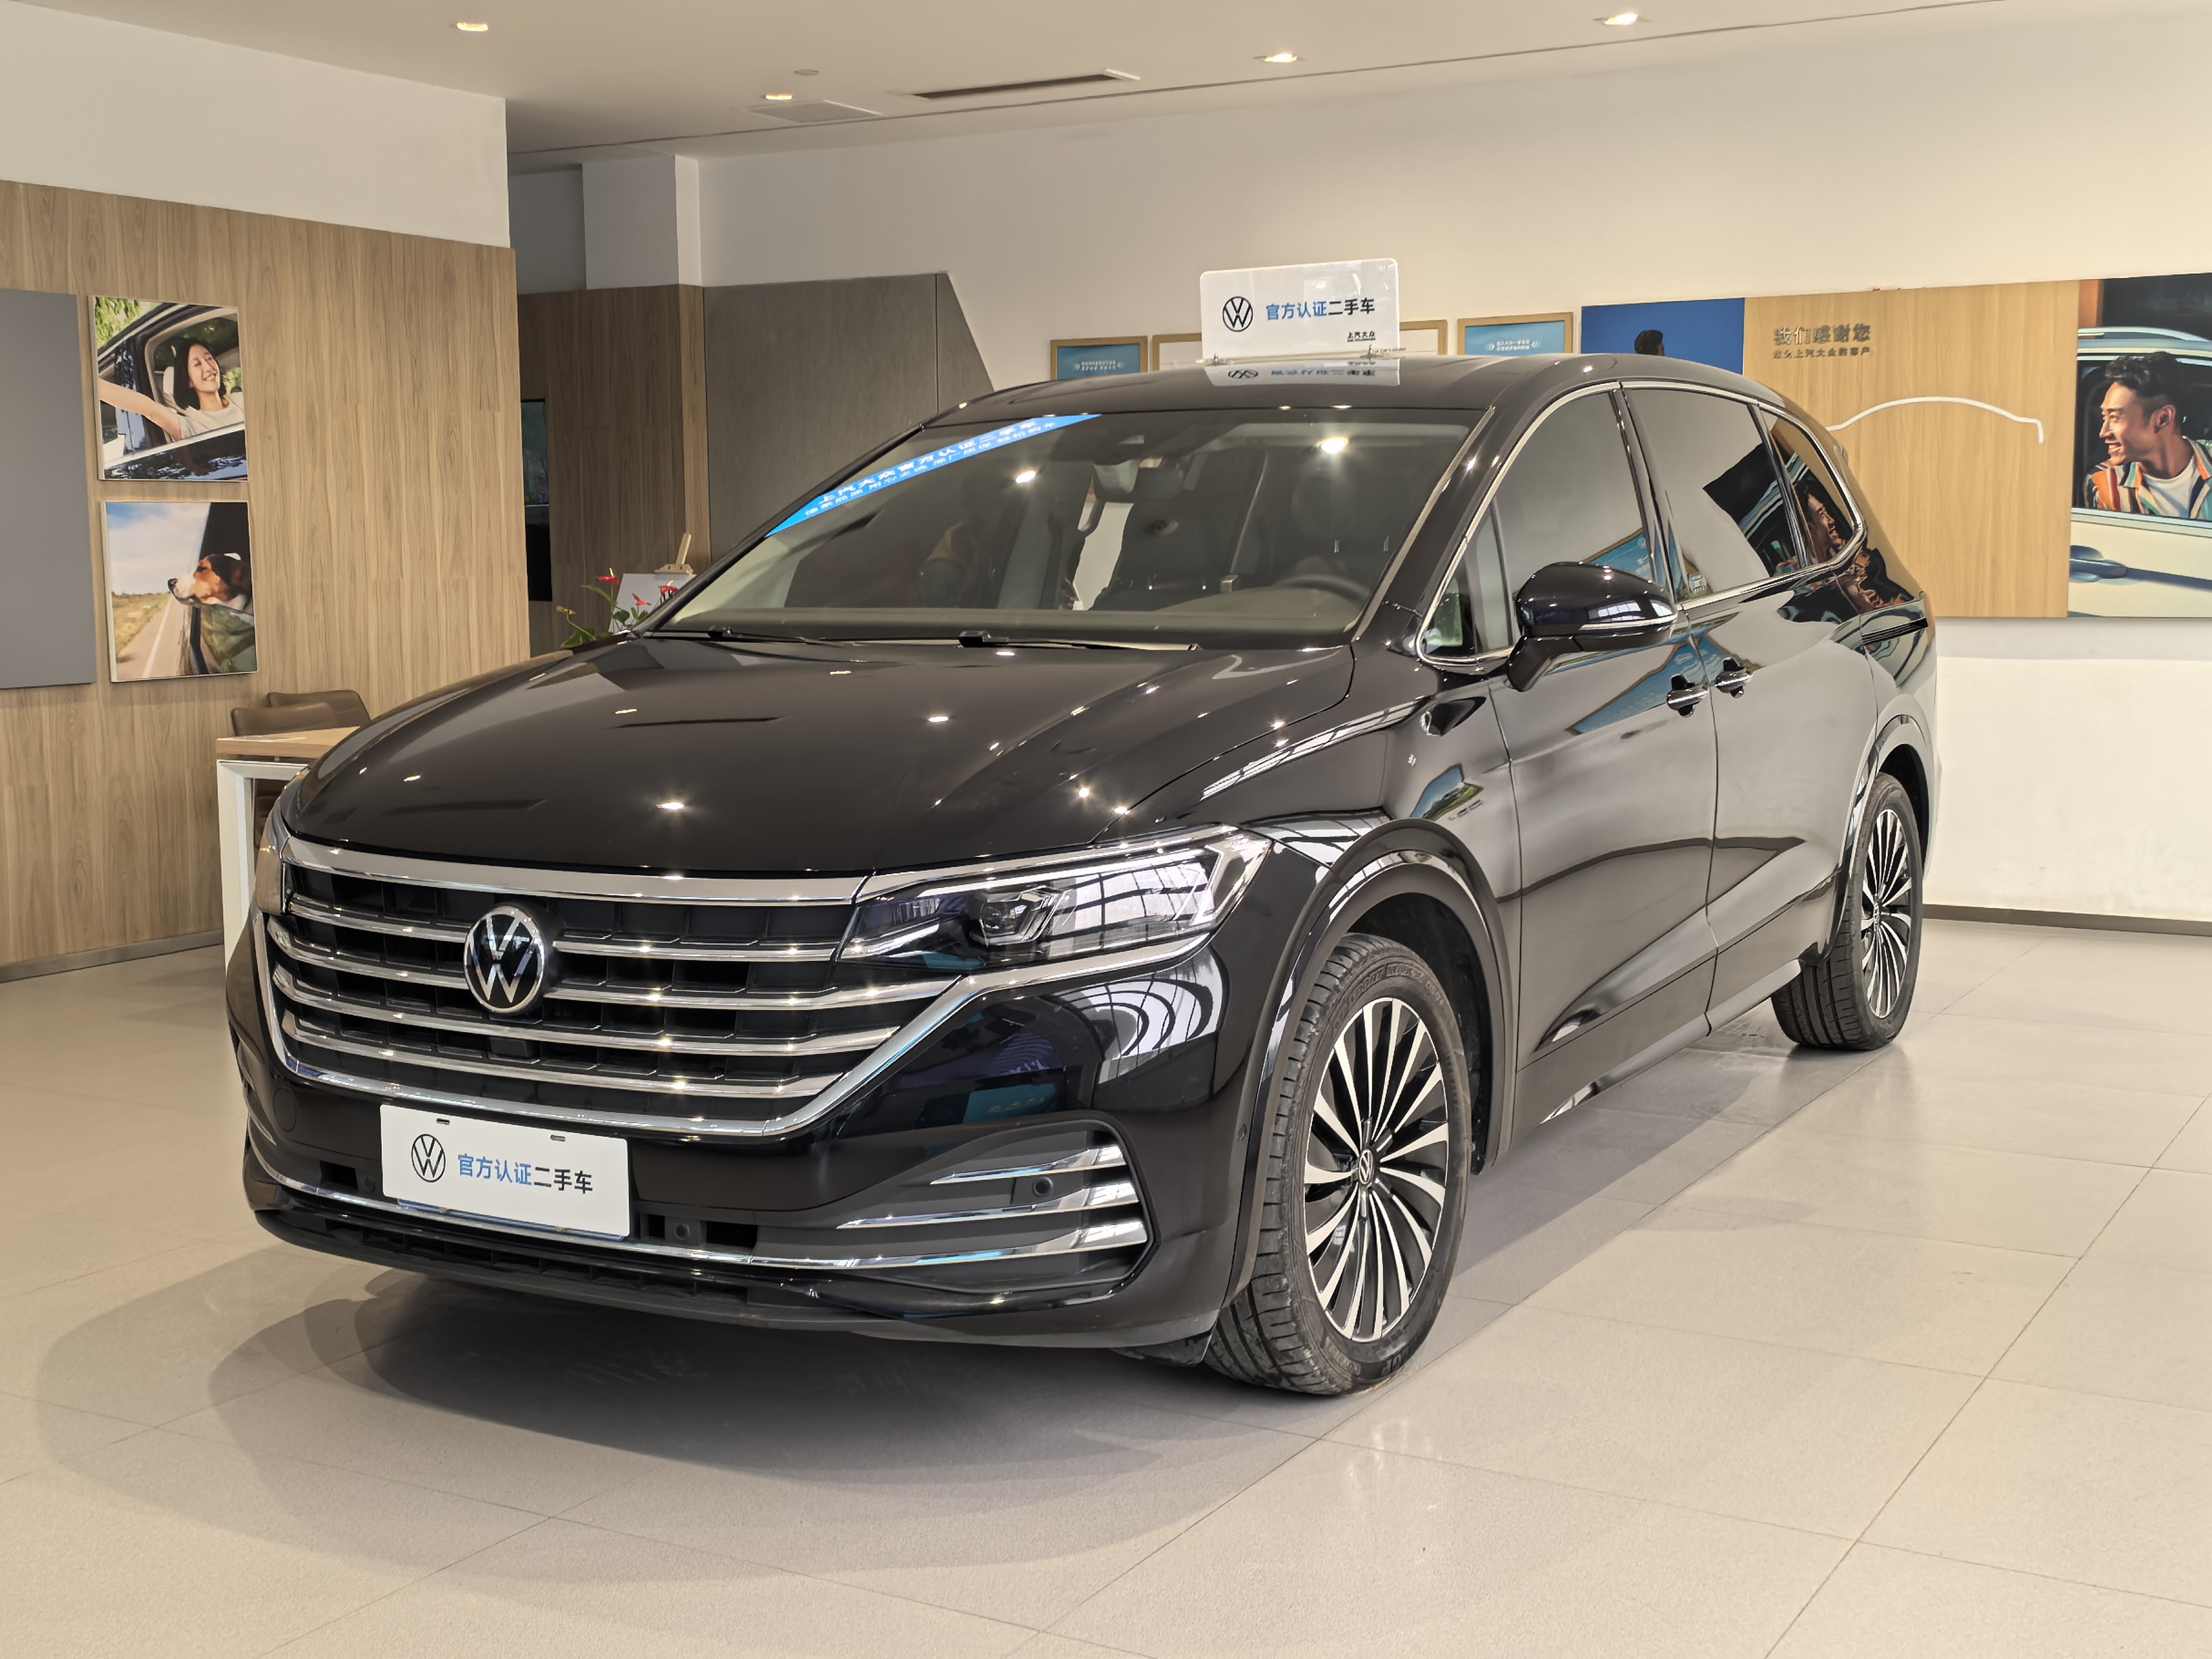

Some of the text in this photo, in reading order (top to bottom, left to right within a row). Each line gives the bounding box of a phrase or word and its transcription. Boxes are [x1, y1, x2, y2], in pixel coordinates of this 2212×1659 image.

[1266, 297, 1375, 320] 官方认证二手车
[464, 906, 545, 1014] VW
[458, 1153, 593, 1195] 官方认证二手车
